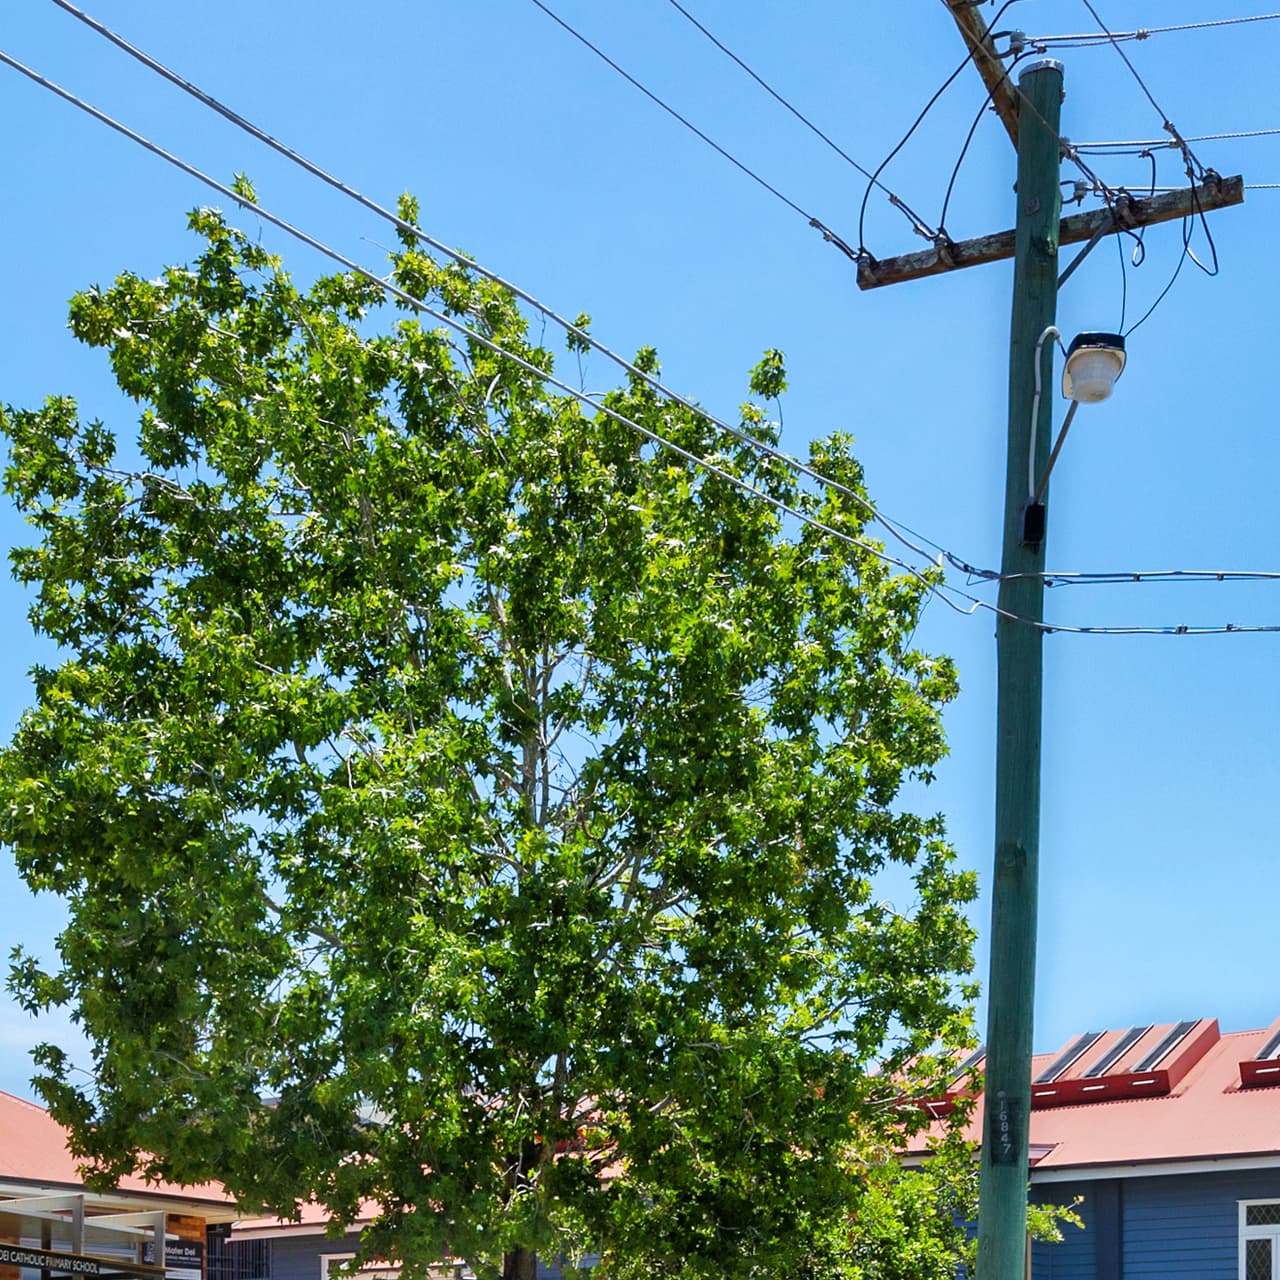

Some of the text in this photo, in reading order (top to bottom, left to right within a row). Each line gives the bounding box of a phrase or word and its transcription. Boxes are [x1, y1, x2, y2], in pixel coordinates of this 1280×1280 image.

[1000, 1100, 1011, 1154] 16847
[10, 1251, 46, 1266] CATHOLIC
[46, 1256, 73, 1270] PRIMARY
[73, 1261, 99, 1273] SCHOOL
